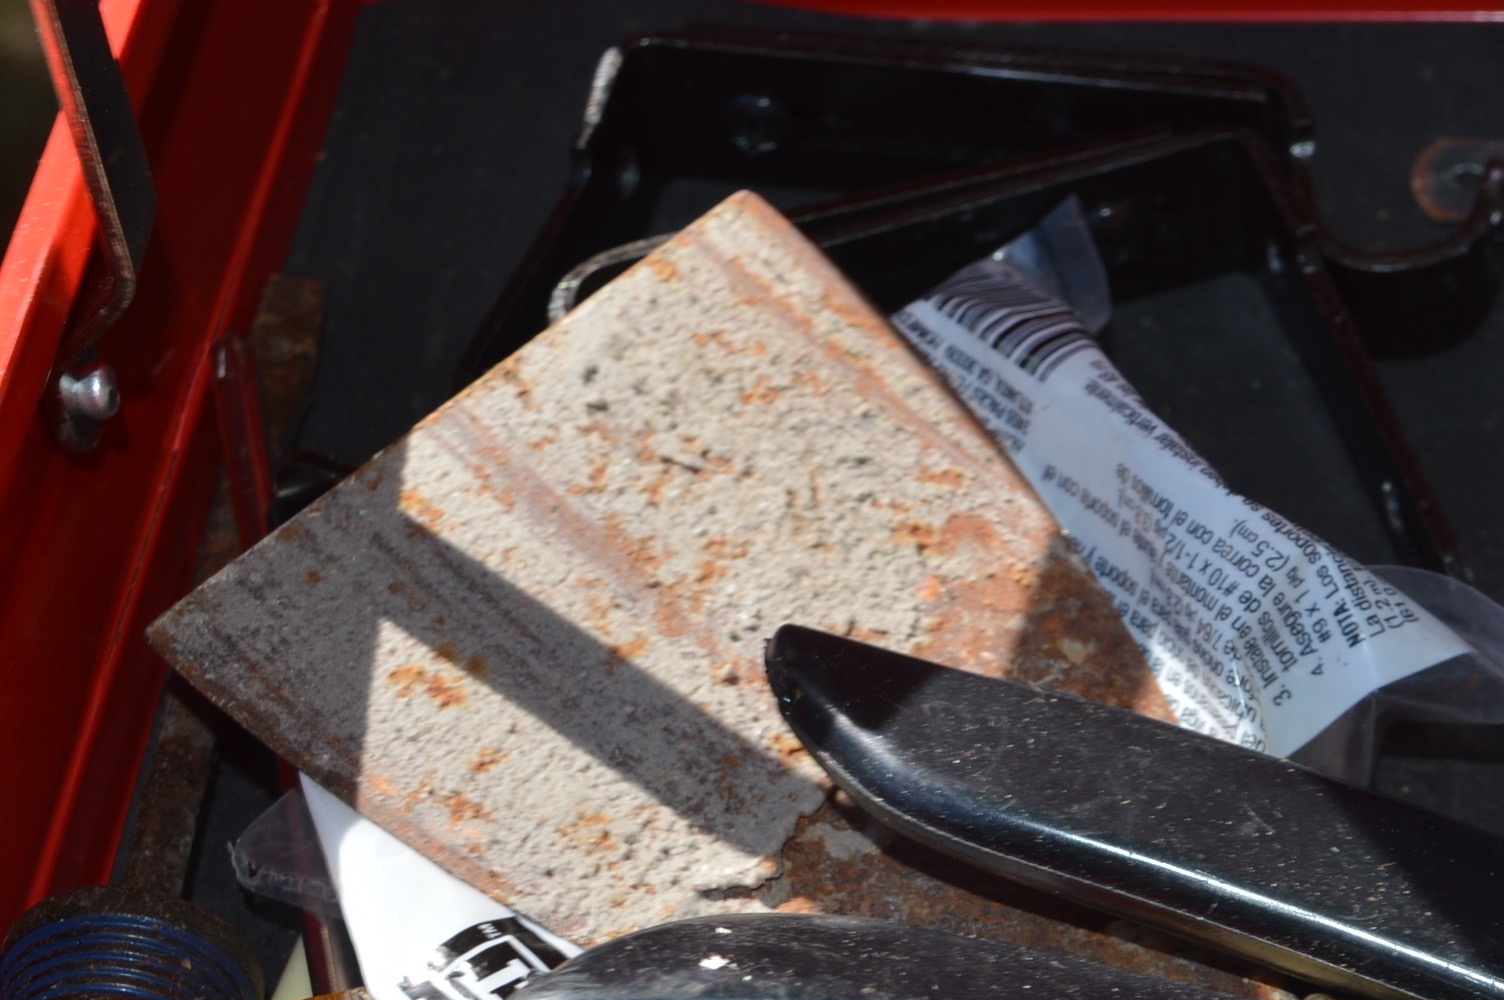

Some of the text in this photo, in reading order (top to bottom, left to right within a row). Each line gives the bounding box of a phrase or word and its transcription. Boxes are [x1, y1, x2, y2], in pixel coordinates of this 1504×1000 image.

[1084, 378, 1156, 435] verticalmente
[1153, 431, 1201, 469] instalar
[1168, 509, 1189, 529] el
[1184, 519, 1215, 547] con
[1230, 518, 1259, 544] cm).
[1162, 532, 1201, 571] 1-1/2
[1261, 511, 1322, 564] soportes
[1210, 537, 1260, 579] correa
[1252, 538, 1290, 571] (2.5
[1204, 565, 1240, 599] #10
[1257, 573, 1276, 598] la
[1314, 564, 1339, 600] Los
[1212, 603, 1234, 625] el
[1237, 588, 1262, 617] de
[1373, 598, 1403, 627] (1.2
[1229, 615, 1252, 638] en
[1270, 591, 1317, 656] Asegure
[1309, 616, 1332, 644] #9
[1335, 596, 1365, 647] NOTA:
[1363, 613, 1385, 636] La
[1255, 610, 1298, 673] tornillos
[1243, 635, 1278, 689] Instale
[1309, 656, 1322, 679] 4.
[1271, 682, 1293, 709] 3.
